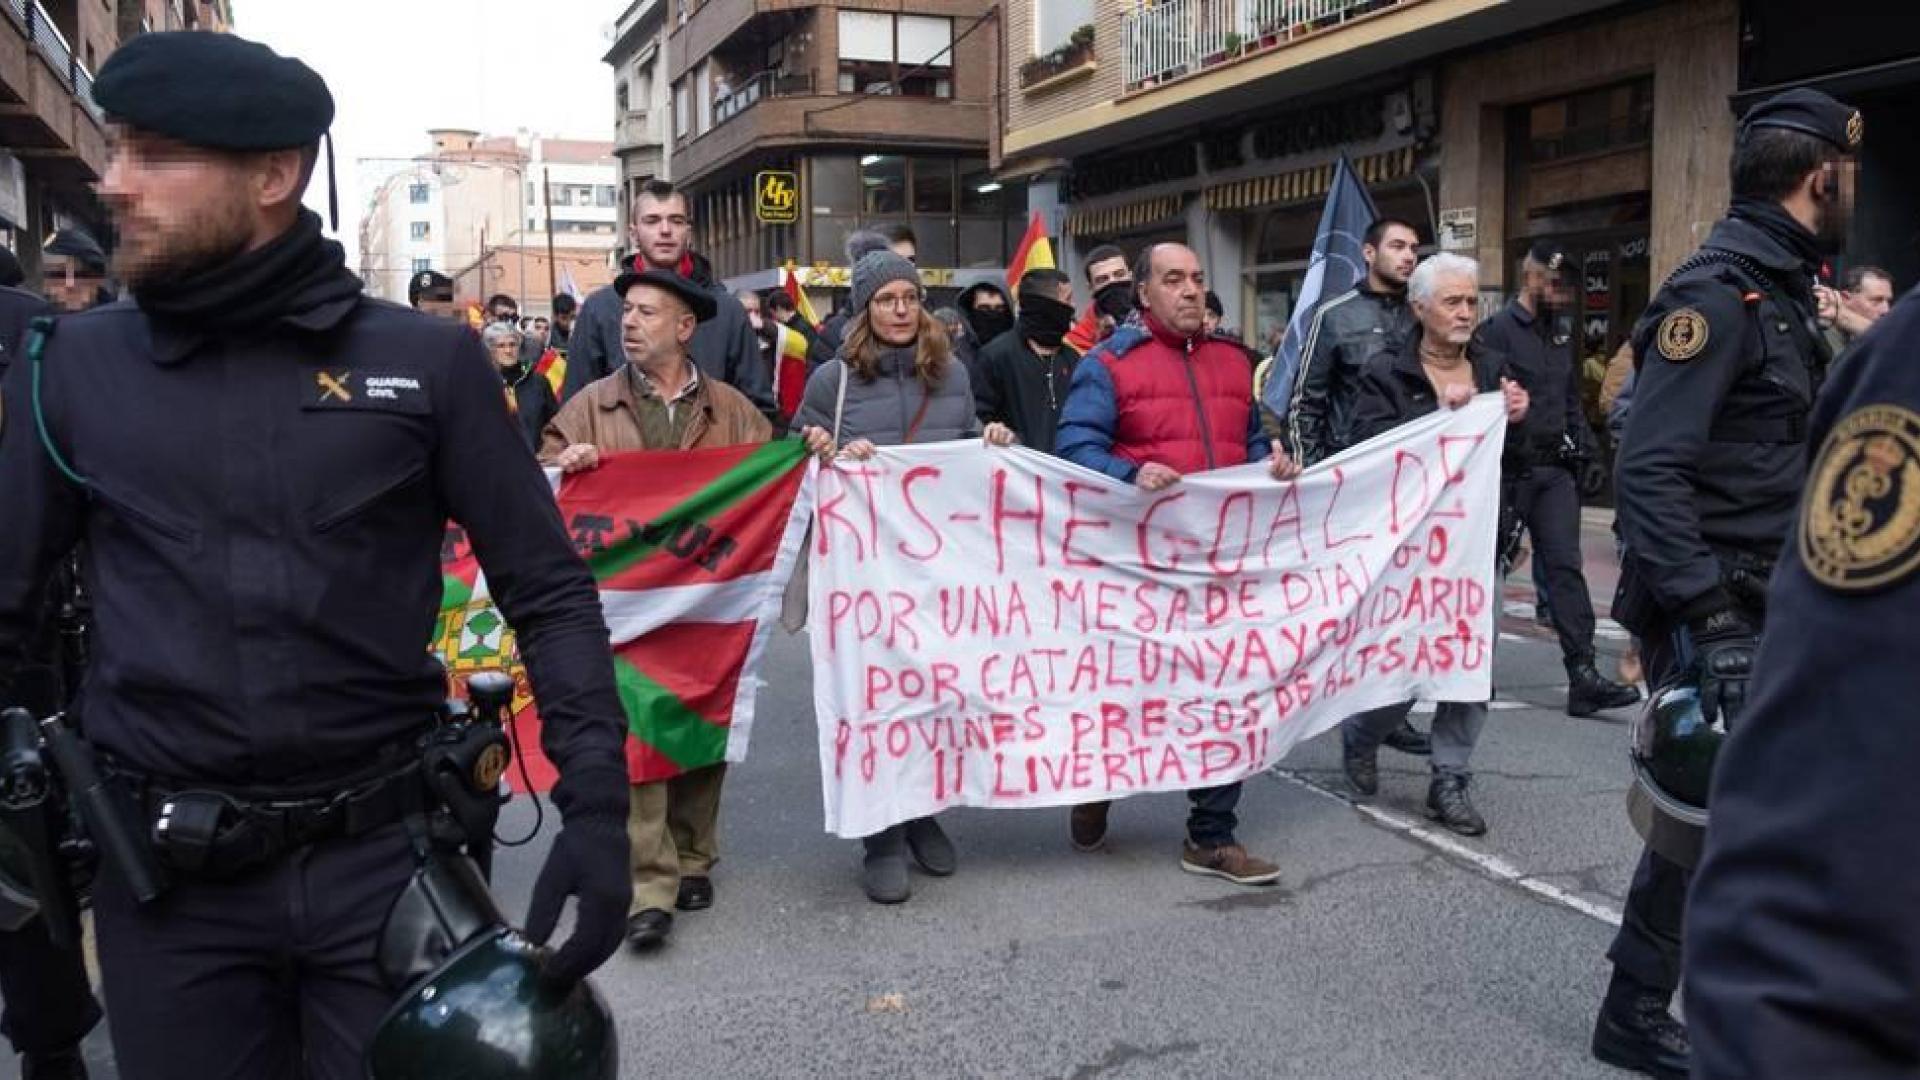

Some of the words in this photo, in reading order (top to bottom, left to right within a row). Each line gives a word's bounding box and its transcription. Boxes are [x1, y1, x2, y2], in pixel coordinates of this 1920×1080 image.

[366, 377, 420, 389] GUARDIA
[367, 388, 398, 399] CIVIL
[828, 592, 919, 650] POR
[940, 580, 1031, 637] UNA
[867, 663, 966, 711] POR
[1070, 692, 1261, 753] PRESOS
